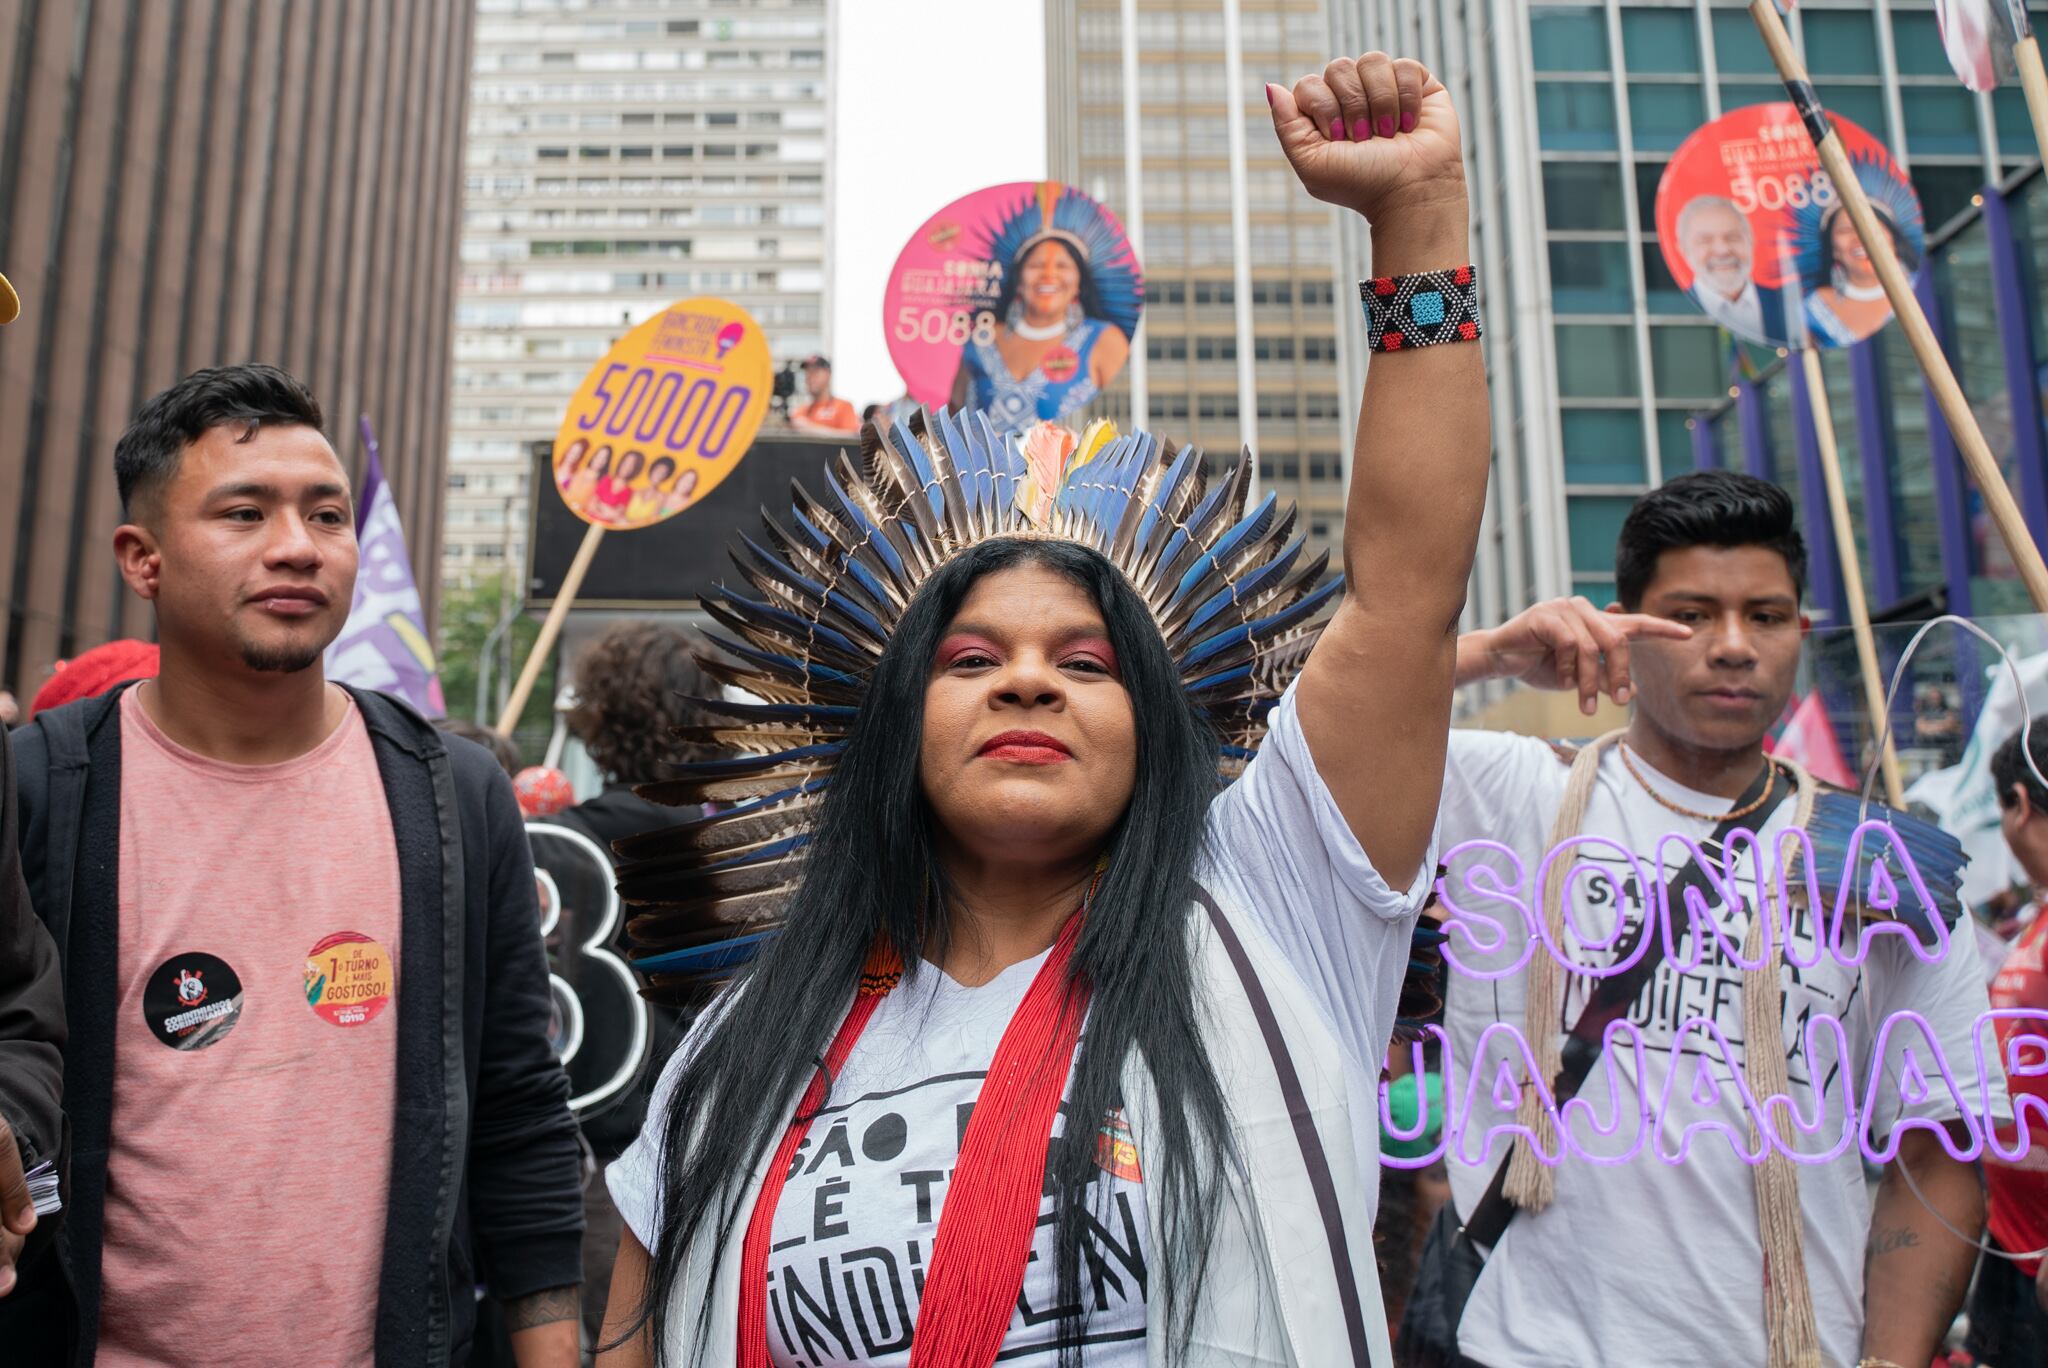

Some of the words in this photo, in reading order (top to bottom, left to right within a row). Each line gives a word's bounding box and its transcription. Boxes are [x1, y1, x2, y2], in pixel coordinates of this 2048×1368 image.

[1730, 170, 1839, 214] 5088
[895, 307, 996, 347] 5088
[578, 363, 751, 459] 50000
[1438, 820, 1950, 980] SONIA
[345, 958, 379, 972] TURNO
[327, 982, 386, 1000] GOSTOSO!
